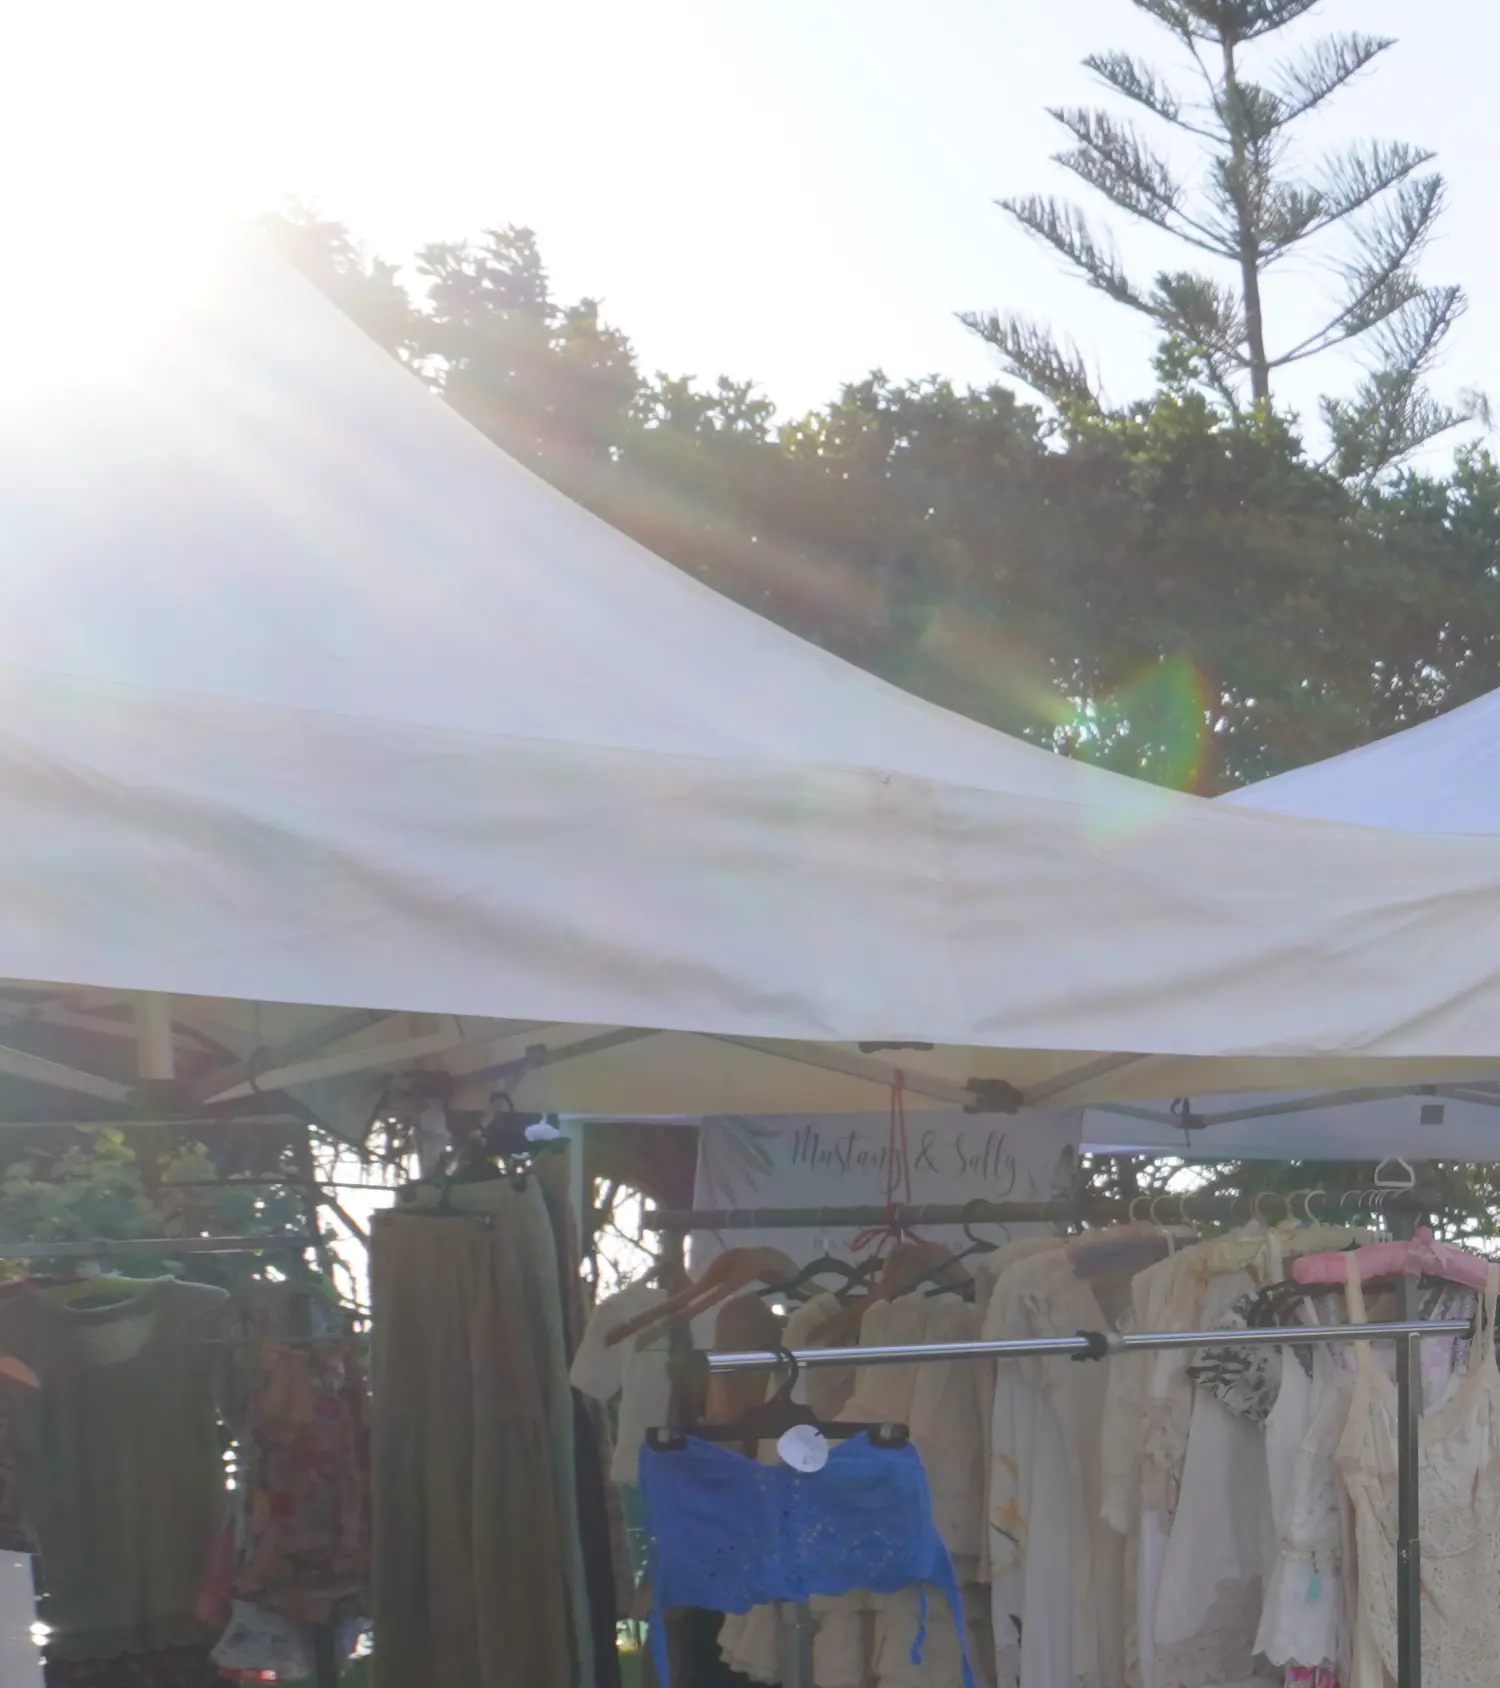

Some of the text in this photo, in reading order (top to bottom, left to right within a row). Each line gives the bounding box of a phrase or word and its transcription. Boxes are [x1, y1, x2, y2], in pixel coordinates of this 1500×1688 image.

[792, 1124, 1017, 1196] Mustang & Sally
